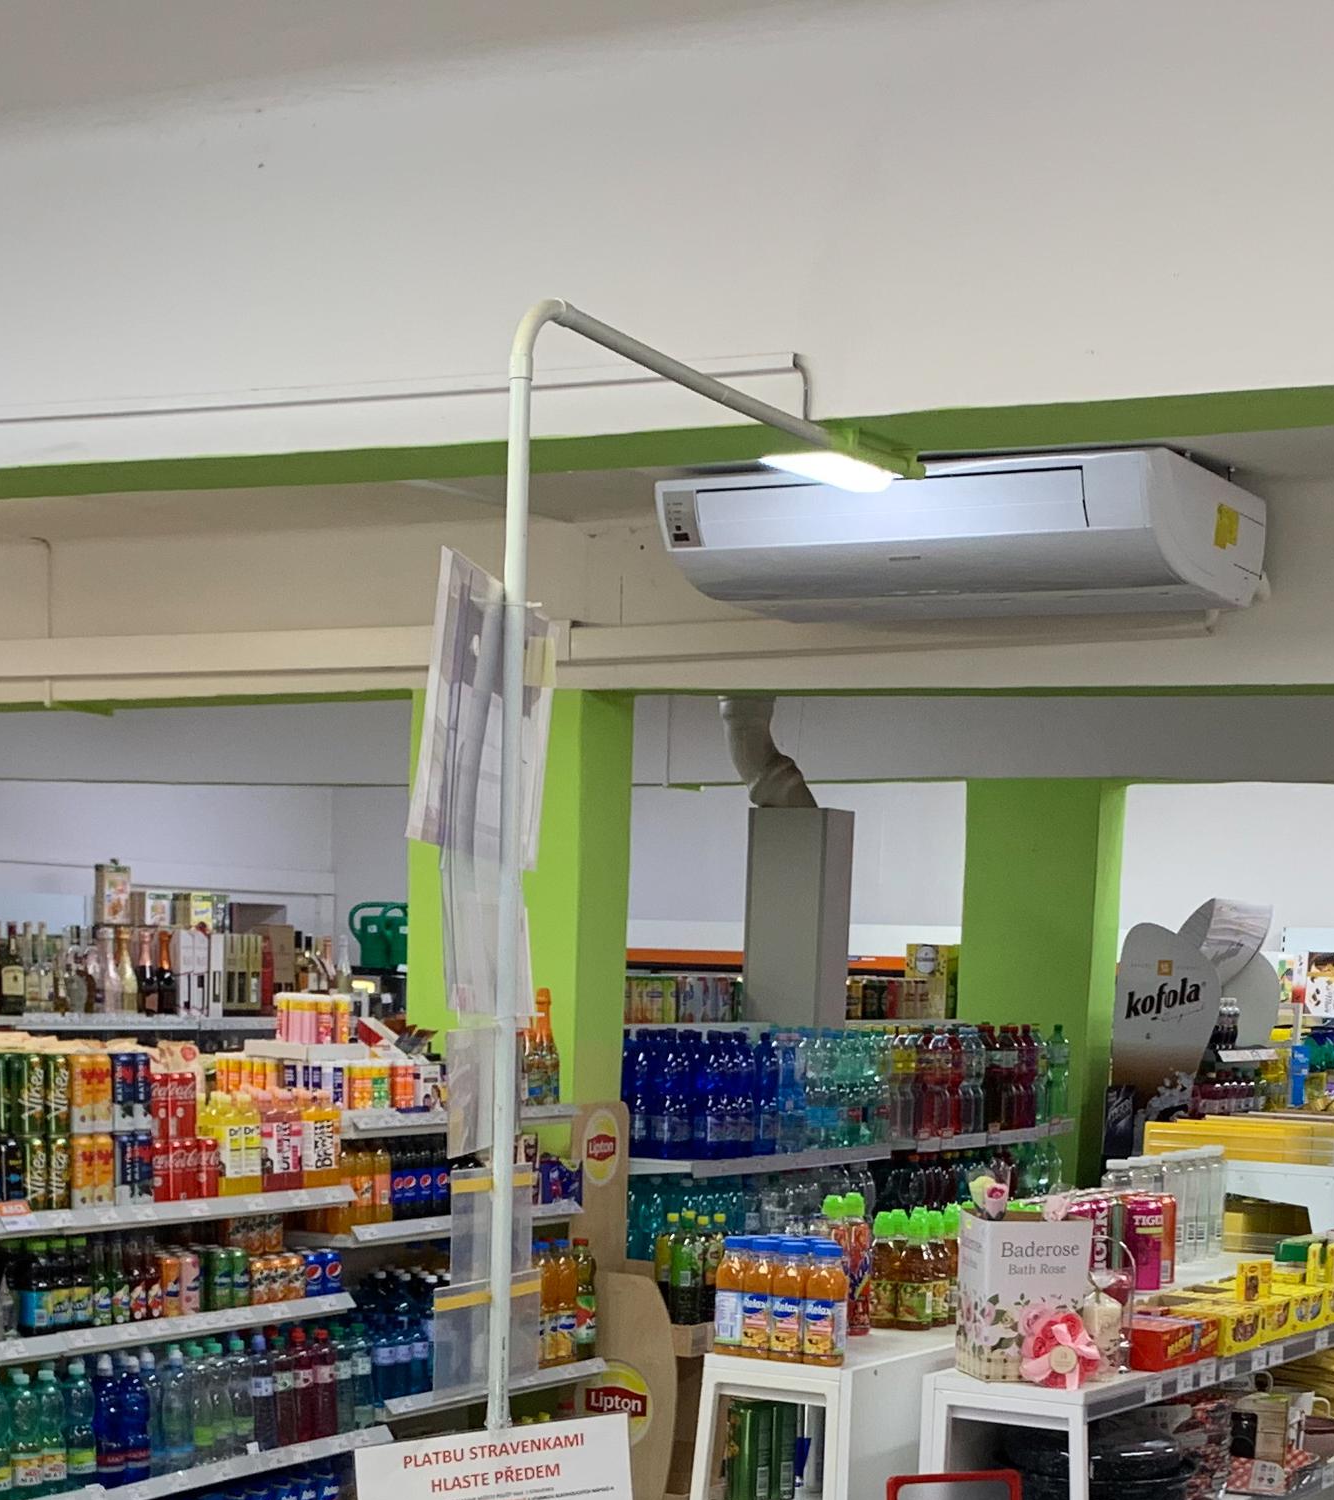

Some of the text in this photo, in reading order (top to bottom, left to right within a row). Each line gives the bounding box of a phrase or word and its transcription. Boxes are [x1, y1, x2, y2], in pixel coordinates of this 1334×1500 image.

[1125, 977, 1200, 1019] kofola
[1001, 1241, 1080, 1258] Baderose
[1008, 1263, 1068, 1275] Bath Rose
[590, 1391, 642, 1414] Lipton
[403, 1433, 585, 1469] PLATBU STRAVENKAMI
[430, 1462, 561, 1494] HLASTE PŘEDEM
